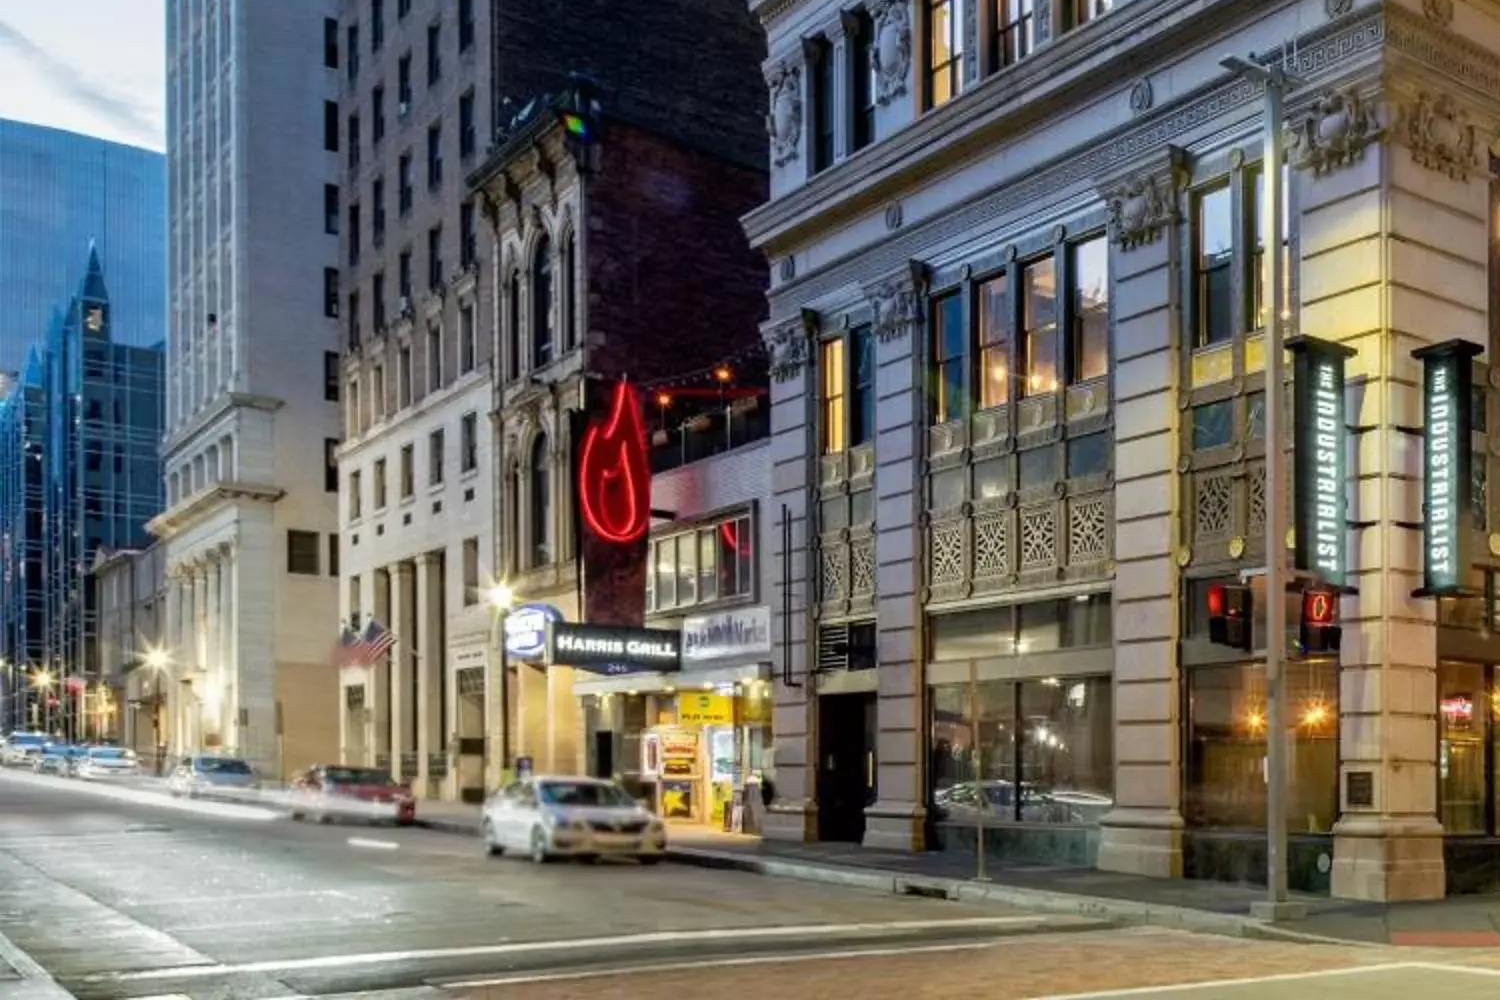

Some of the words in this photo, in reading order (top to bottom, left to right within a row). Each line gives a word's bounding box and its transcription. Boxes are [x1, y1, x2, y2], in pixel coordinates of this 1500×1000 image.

[1320, 365, 1334, 388] THE
[1433, 367, 1446, 392] THE
[1316, 389, 1337, 572] INDUSTRIALIST
[1430, 394, 1449, 574] INDUSTRIALIST
[556, 635, 624, 654] HARRIS
[626, 641, 678, 657] GRILL
